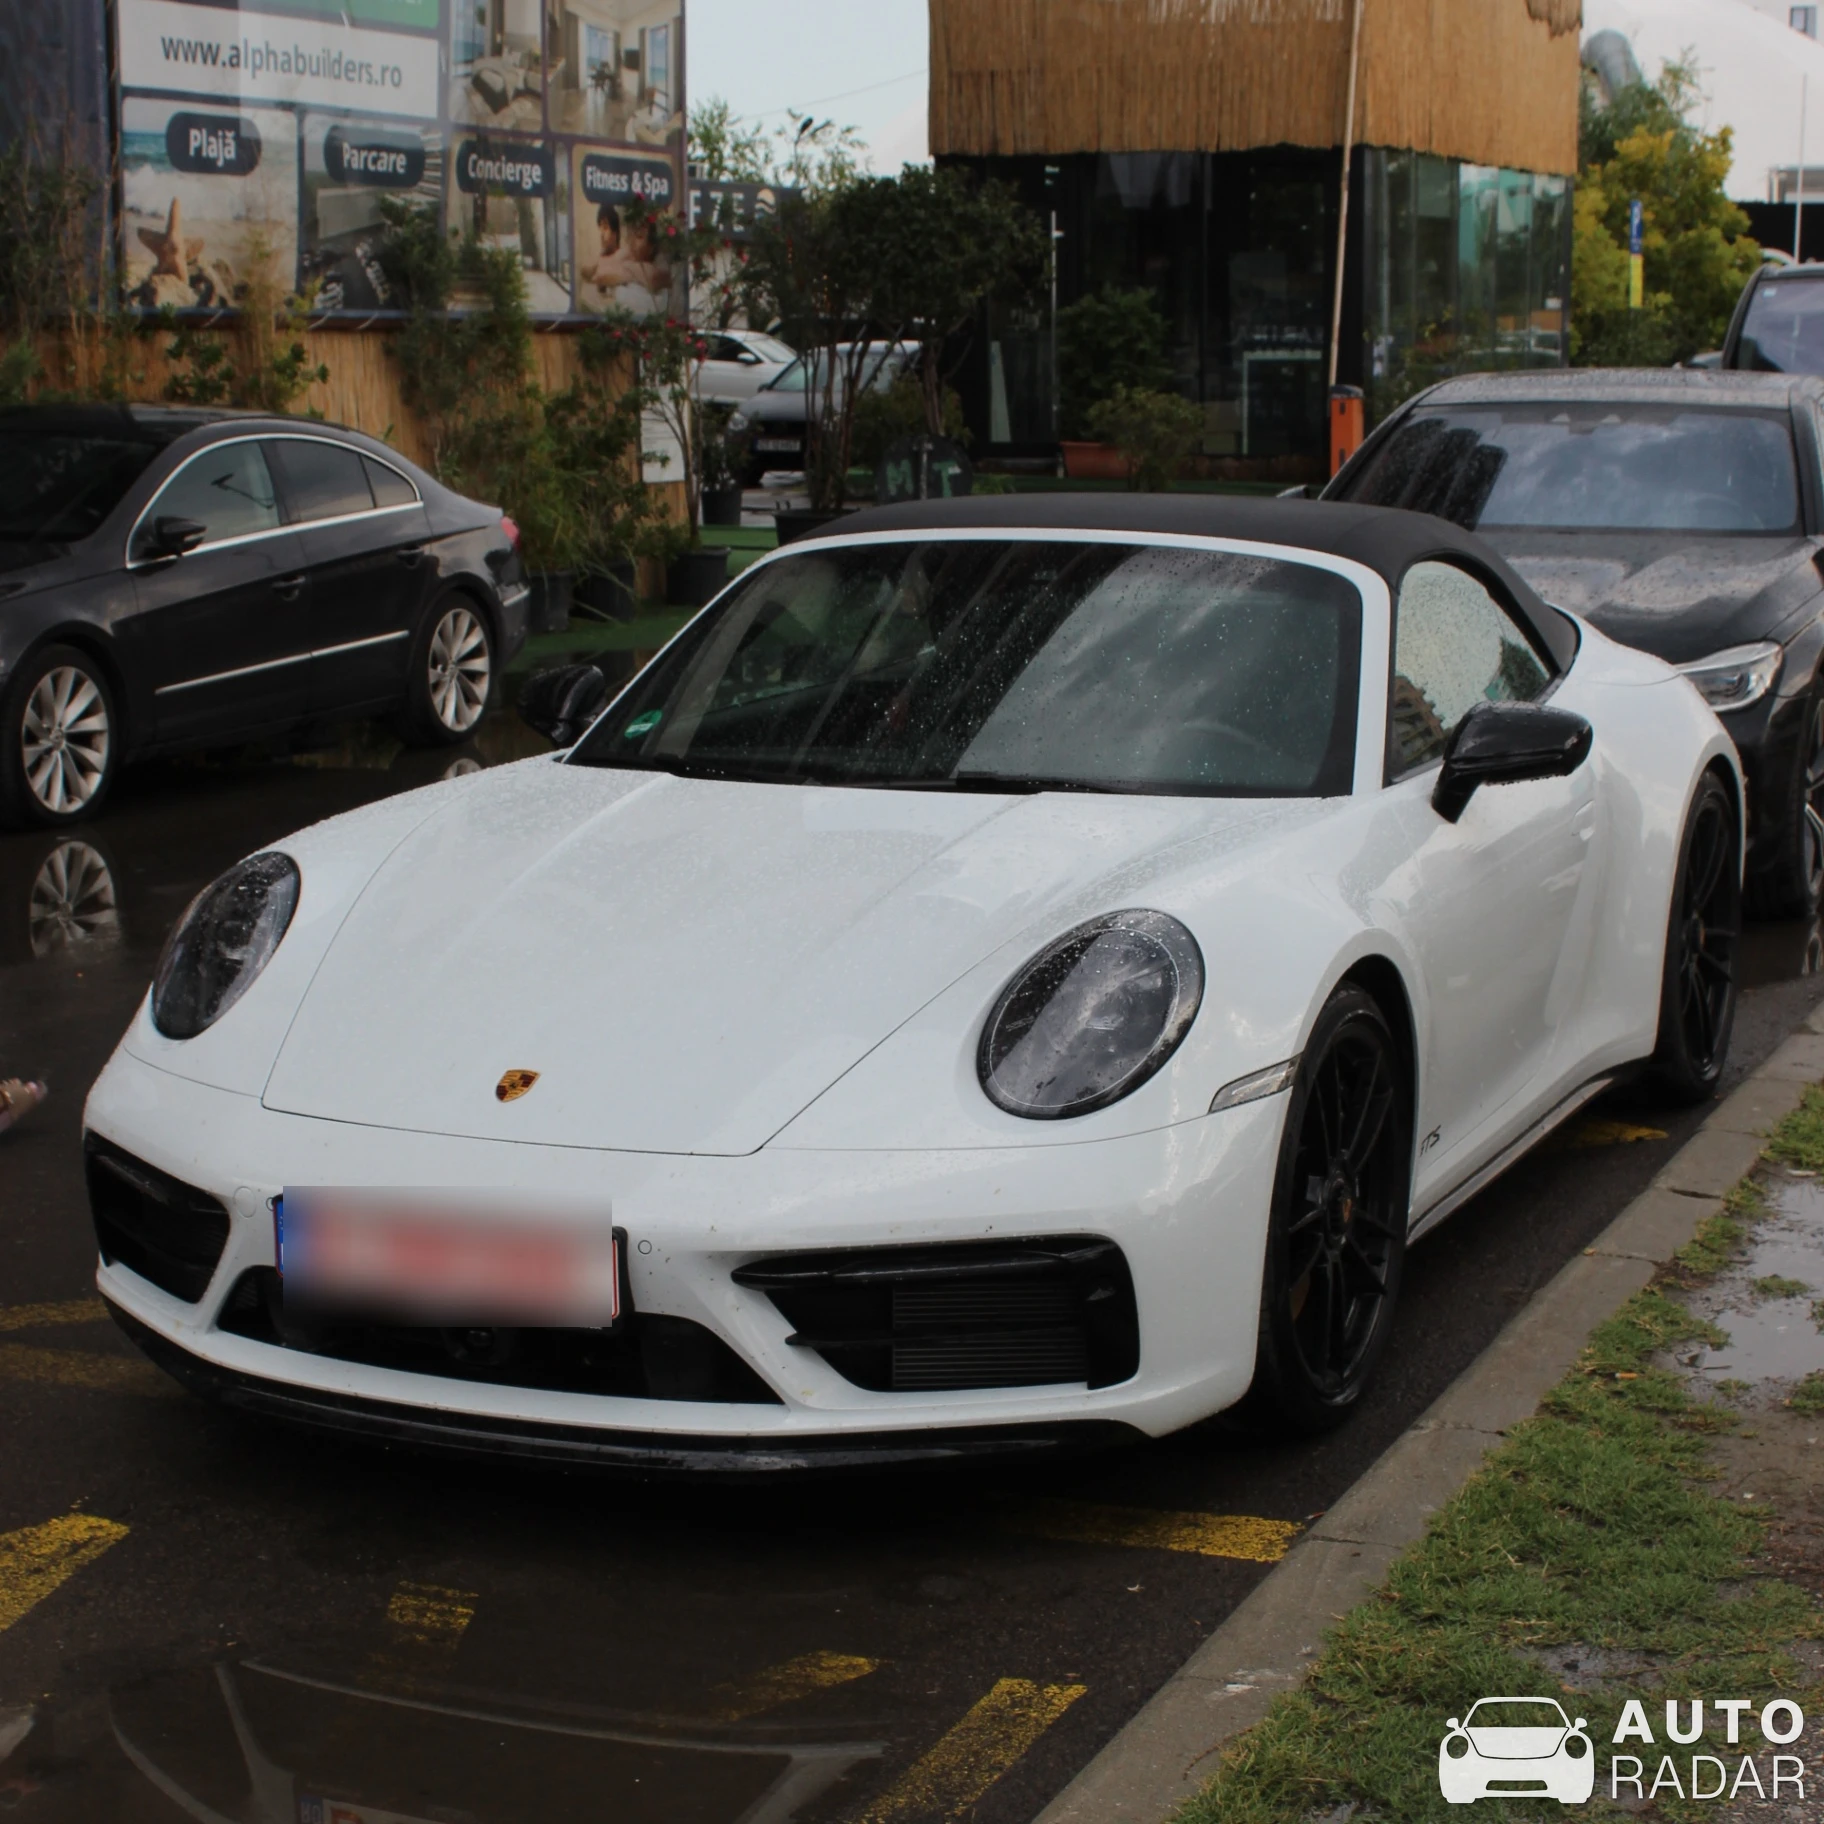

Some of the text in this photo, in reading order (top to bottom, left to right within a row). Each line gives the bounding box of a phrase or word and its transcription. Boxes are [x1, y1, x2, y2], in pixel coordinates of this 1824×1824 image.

[161, 35, 402, 88] www.alphabuilders.ro
[188, 127, 237, 168] Plajă
[342, 141, 407, 175] Parcare
[467, 152, 542, 190] Concierge
[585, 165, 669, 201] Fitness & Spa
